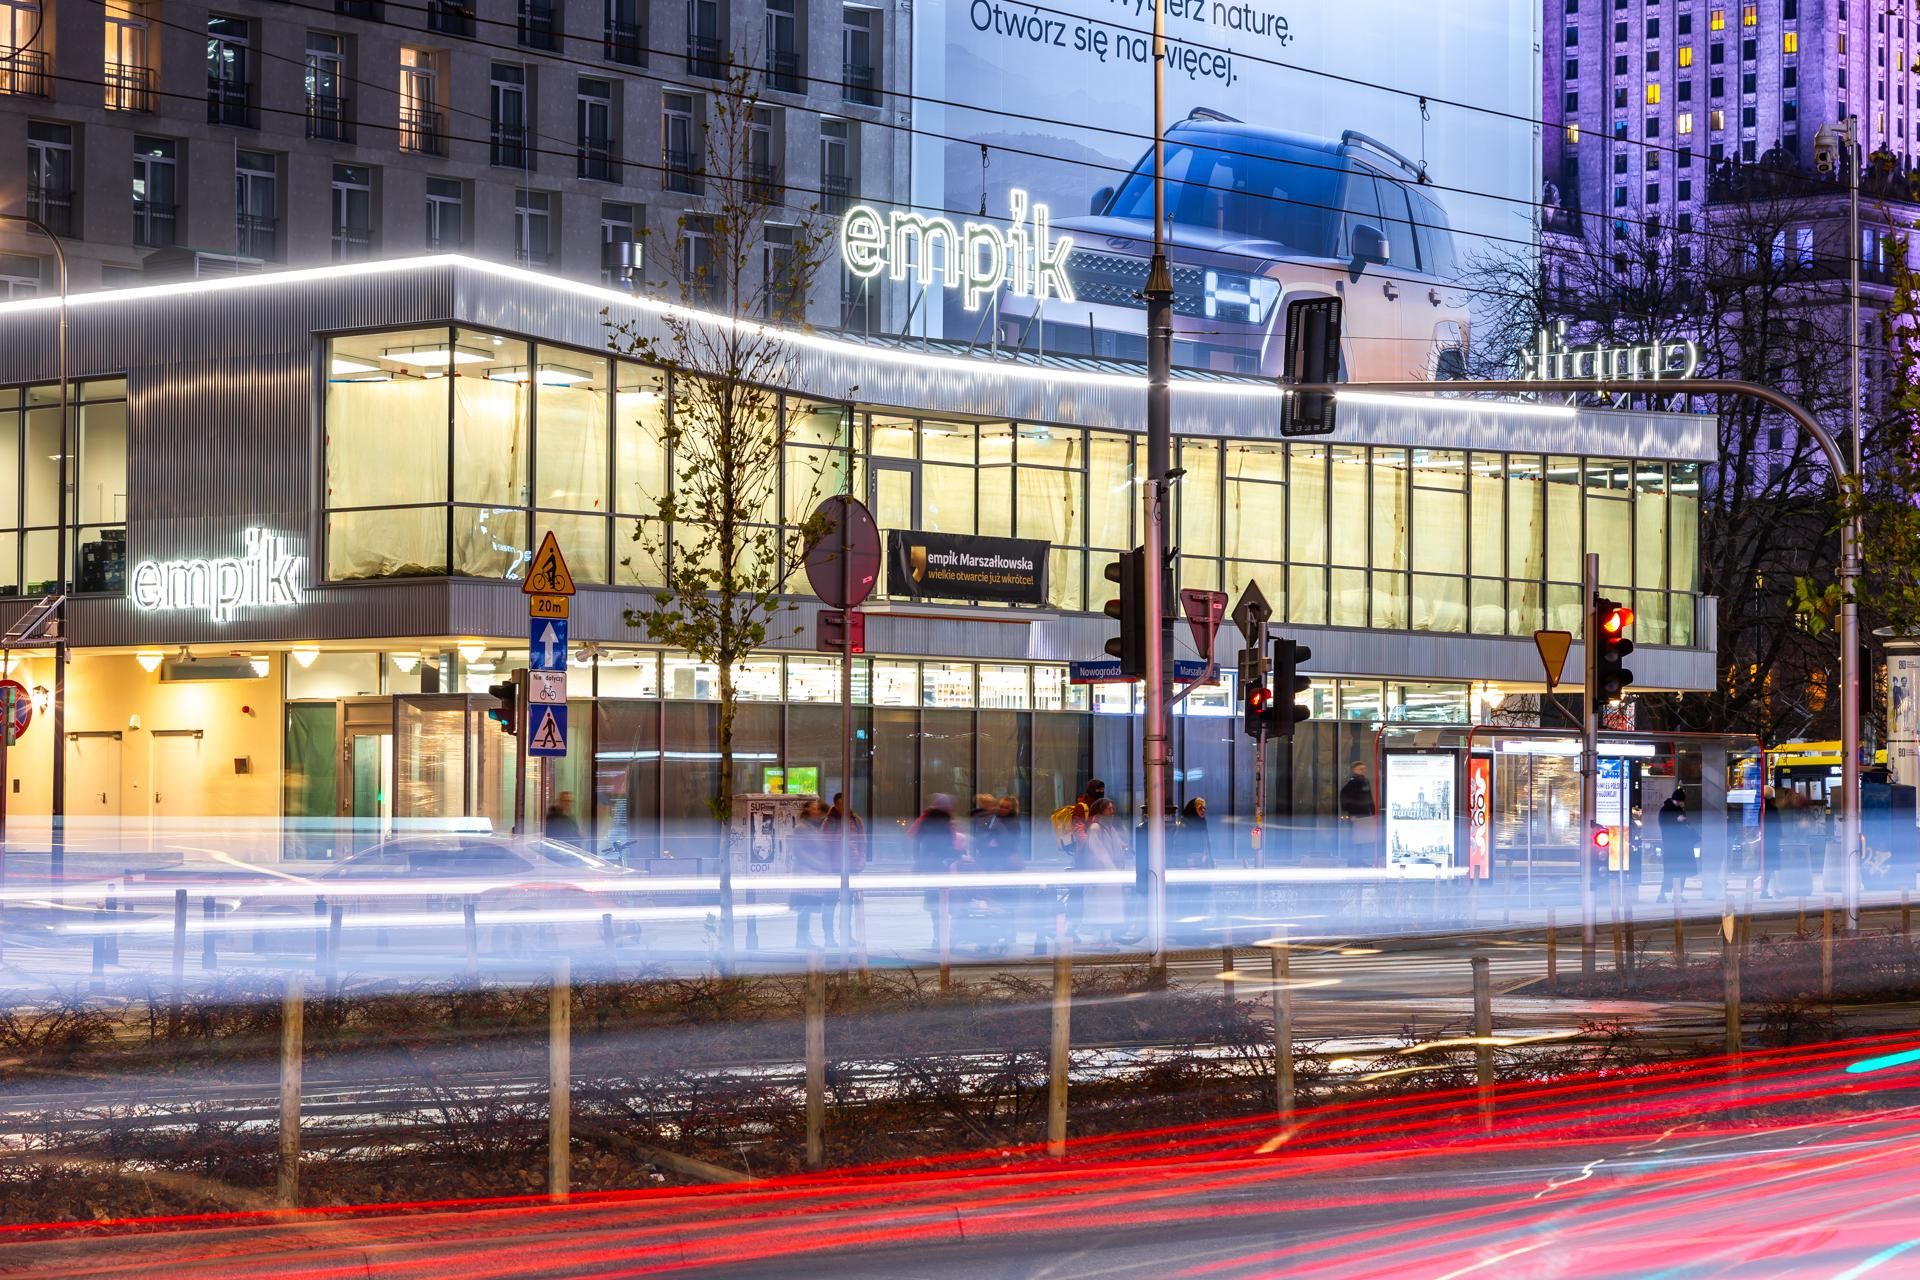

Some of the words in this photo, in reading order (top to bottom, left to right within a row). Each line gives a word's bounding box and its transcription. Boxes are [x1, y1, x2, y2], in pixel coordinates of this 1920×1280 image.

[971, 0, 1066, 47] Otwórz
[1074, 20, 1108, 62] się
[1117, 34, 1147, 63] na
[1213, 2, 1294, 47] naturę.
[841, 188, 1075, 311] empik
[131, 526, 304, 622] empik
[927, 550, 958, 567] empik
[959, 553, 1033, 570] Marszałkowska
[928, 569, 956, 580] wielkie
[956, 571, 988, 583] otwarcie
[989, 573, 1001, 585] już
[1001, 573, 1034, 585] wkrótce!
